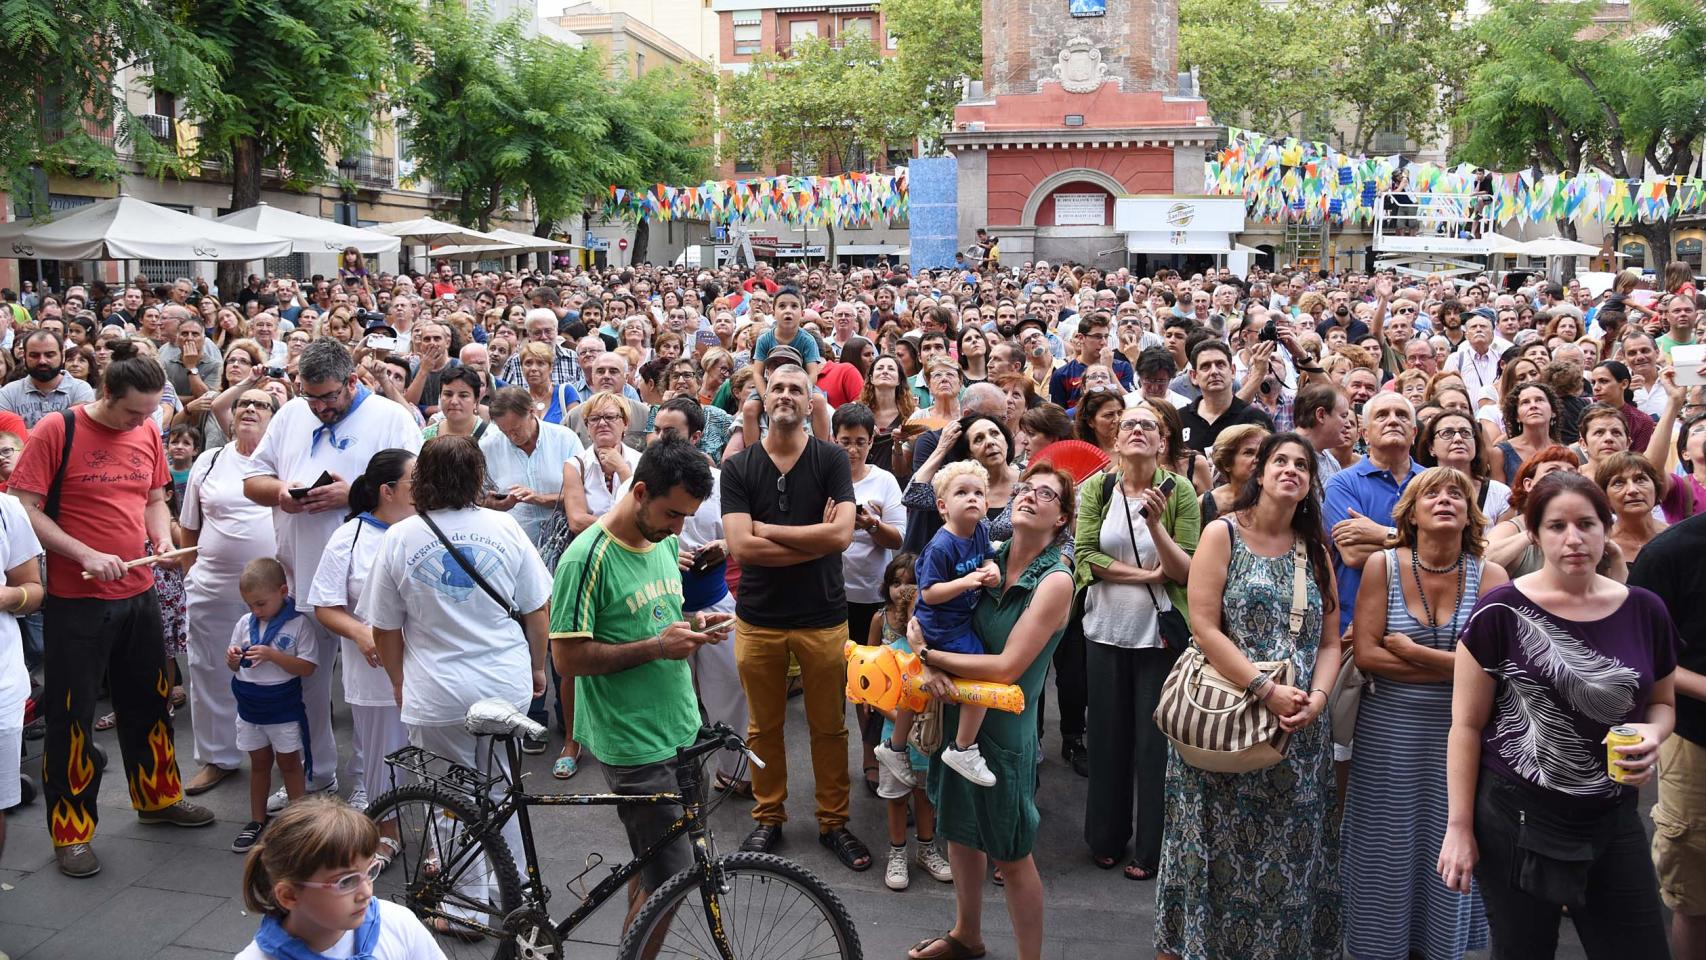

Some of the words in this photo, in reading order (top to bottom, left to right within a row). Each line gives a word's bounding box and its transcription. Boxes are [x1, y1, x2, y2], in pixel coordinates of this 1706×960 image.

[406, 540, 442, 566] Gegan
[452, 532, 466, 542] de
[470, 532, 506, 554] Gràcia
[626, 577, 685, 615] JAMAIC
